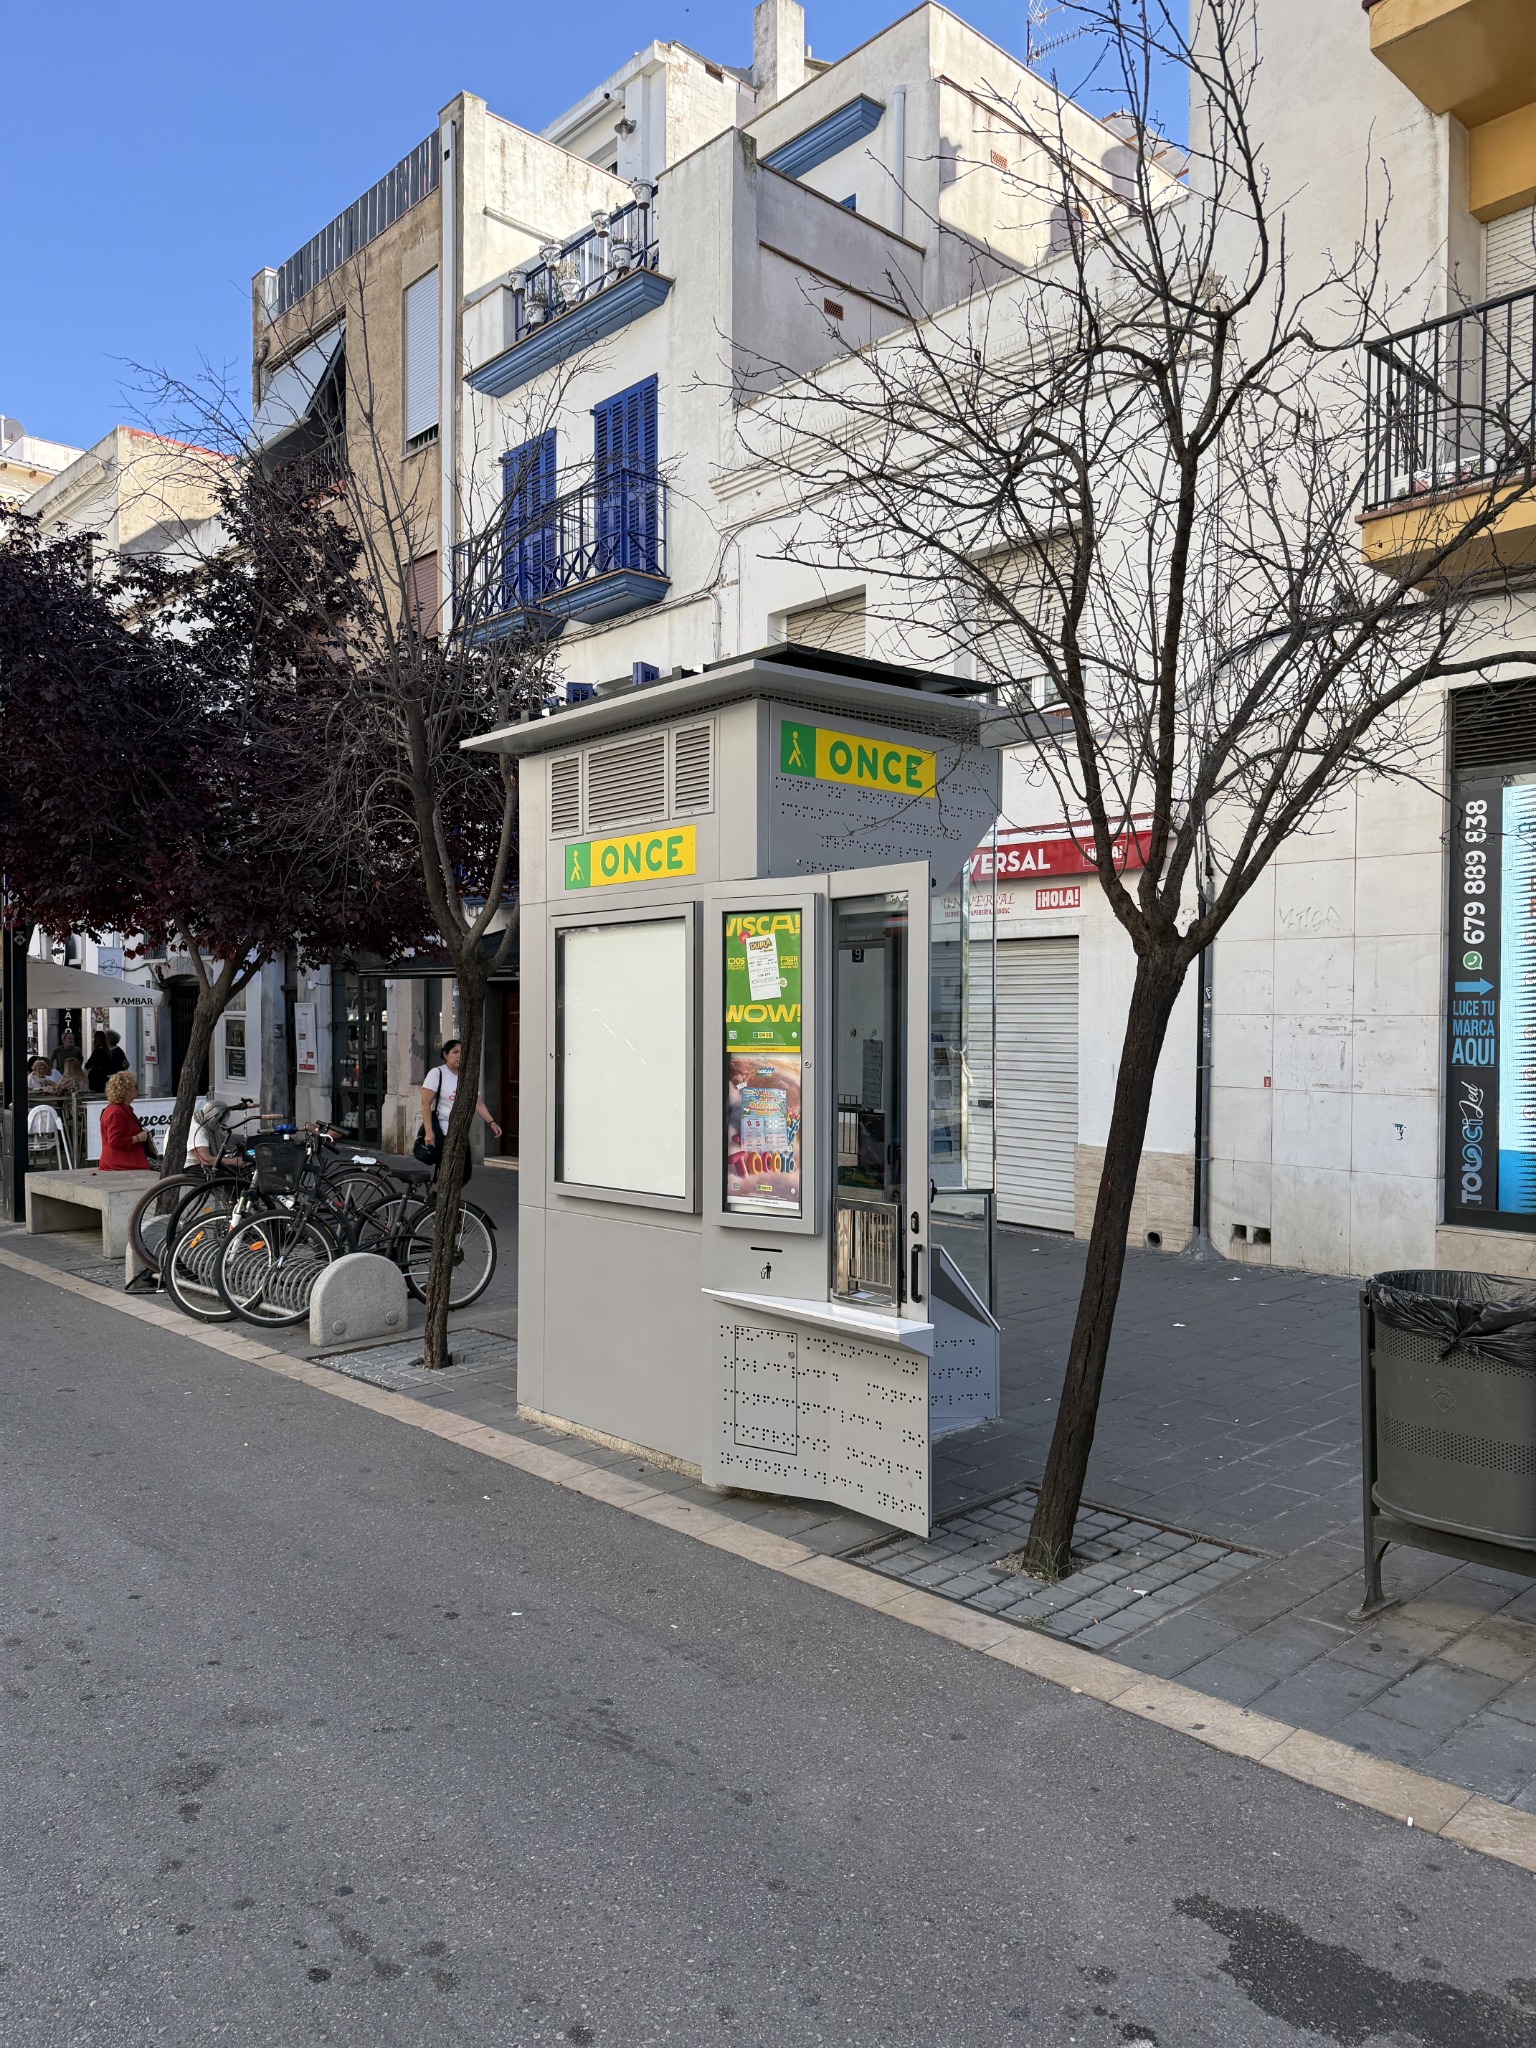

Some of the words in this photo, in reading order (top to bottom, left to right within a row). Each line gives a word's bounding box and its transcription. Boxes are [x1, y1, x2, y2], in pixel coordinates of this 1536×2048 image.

[829, 740, 923, 789] ONCE
[1464, 799, 1488, 844] 838
[601, 835, 683, 877] ONCE
[1464, 850, 1487, 895] 889
[1037, 888, 1079, 909] ¡HOLA!
[726, 914, 800, 937] VISCA!
[1463, 901, 1486, 945] 679
[121, 997, 153, 1005] AMBAR
[726, 1003, 800, 1023] WOW!
[1452, 1000, 1480, 1016] LUCE
[1481, 1000, 1495, 1016] TU
[1452, 1019, 1495, 1037] MARCA
[1451, 1037, 1495, 1066] AQUI
